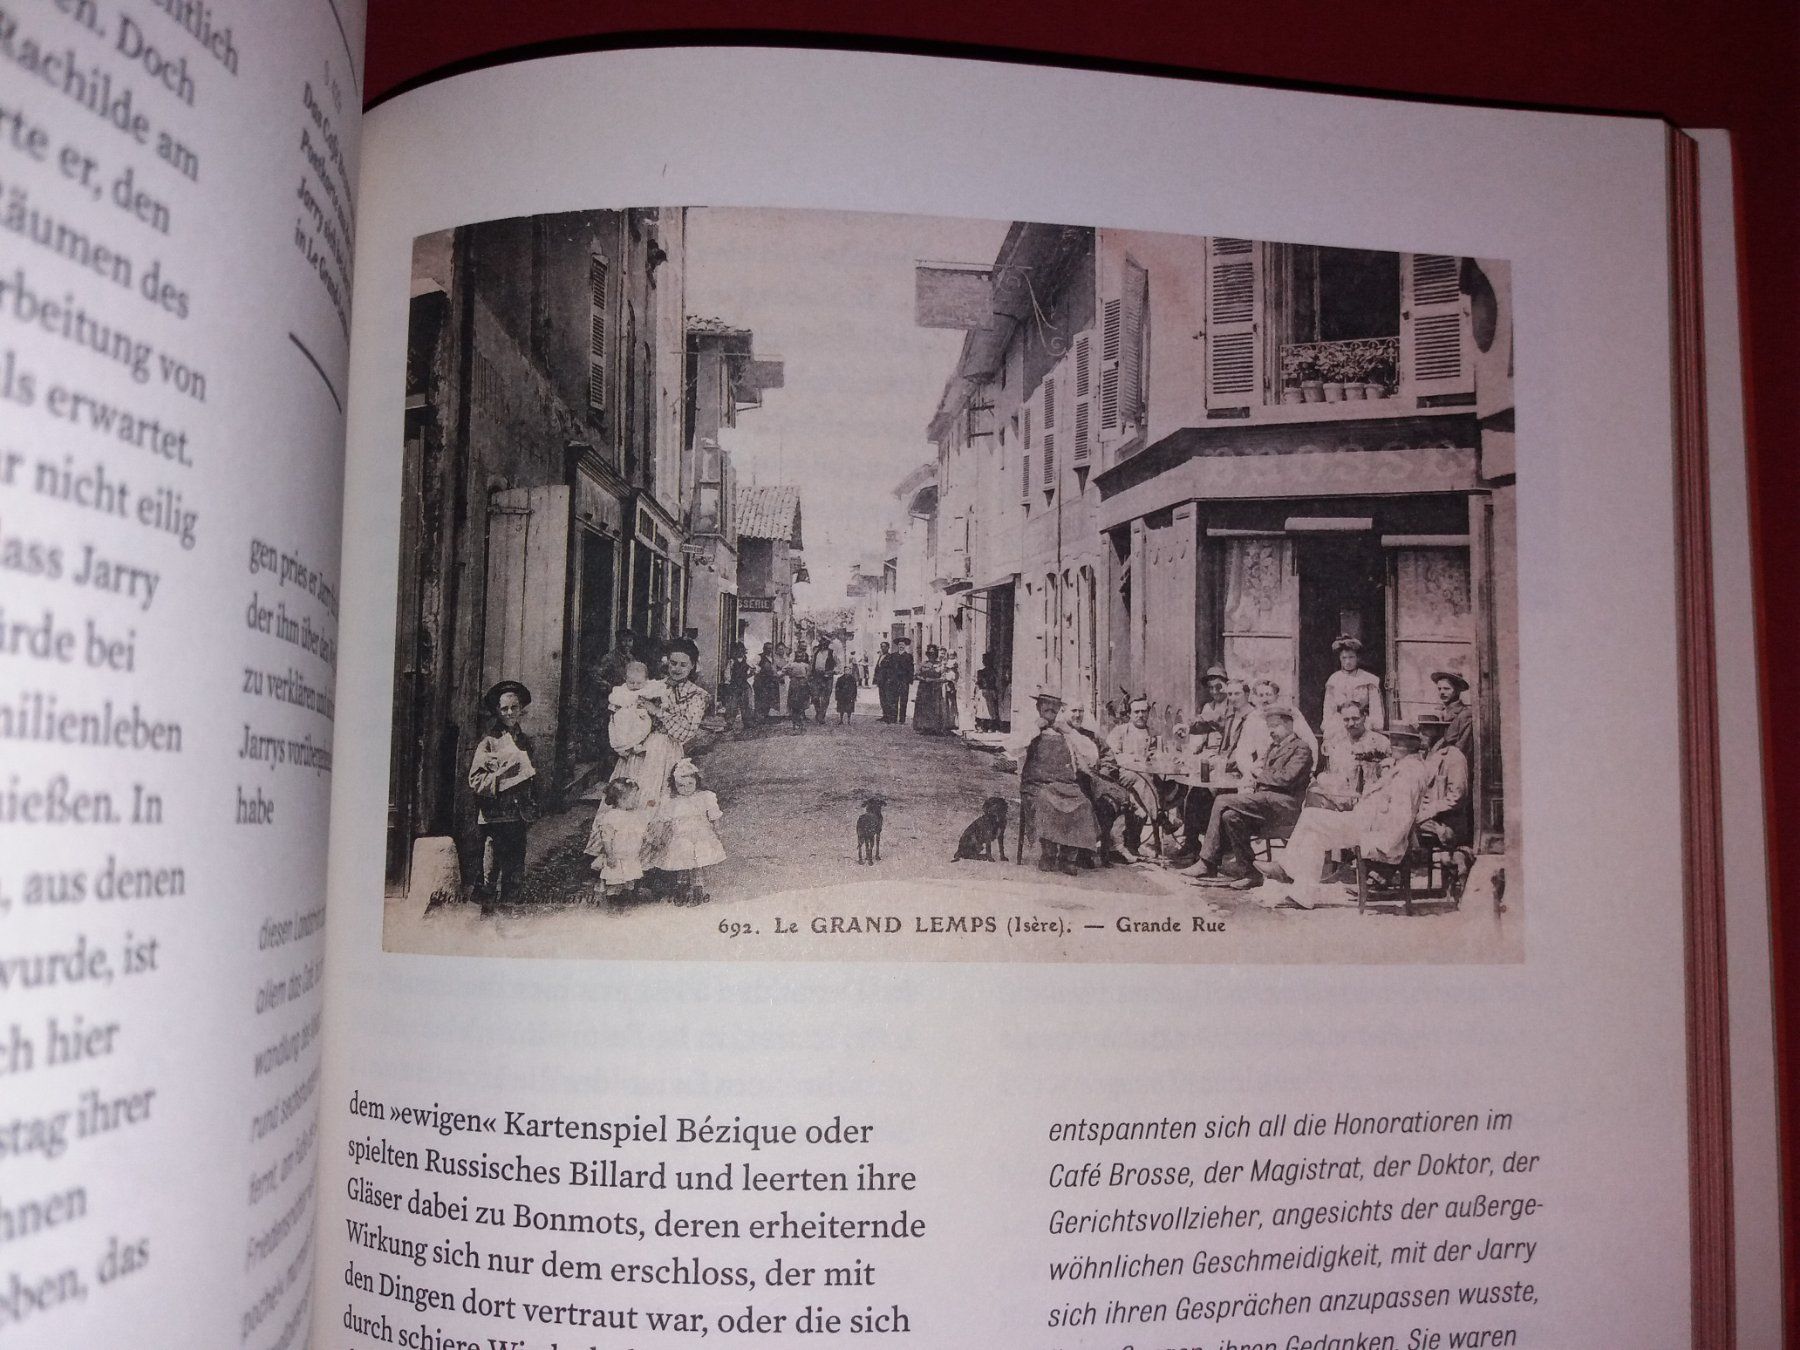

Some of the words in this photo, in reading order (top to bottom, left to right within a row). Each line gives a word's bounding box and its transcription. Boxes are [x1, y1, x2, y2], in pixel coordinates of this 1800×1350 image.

[116, 16, 194, 107] Doch
[156, 127, 199, 182] am
[59, 146, 101, 201] er,
[111, 165, 171, 234] den
[0, 184, 133, 289] äumen
[141, 259, 190, 319] des
[160, 352, 206, 402] von
[46, 384, 194, 467] erwartet.
[35, 455, 127, 518] nicht
[136, 487, 199, 550] eilig
[0, 523, 63, 580] ass
[74, 545, 160, 611] Jarry
[250, 539, 278, 574] gen
[247, 591, 274, 634] der
[276, 602, 299, 645] ihm
[86, 617, 136, 672] bei
[243, 668, 263, 696] zu
[239, 724, 285, 771] Jarrys
[0, 773, 121, 824] ießen.
[132, 784, 163, 825] In
[236, 785, 275, 825] habe
[24, 869, 87, 905] aus
[95, 854, 186, 900] denen
[717, 918, 759, 935] 692.
[774, 917, 799, 933] Le
[811, 917, 901, 933] GRAND
[915, 916, 997, 932] LEMPS
[1116, 916, 1181, 932] Grande
[1192, 917, 1226, 932] Rue
[123, 931, 160, 973] ist
[47, 1015, 120, 1067] hier
[77, 1086, 156, 1140] ihrer
[349, 1090, 385, 1120] dem
[390, 1105, 496, 1135] »ewigen«
[504, 1111, 667, 1148] Kartenspiel
[676, 1115, 797, 1150] Bézique
[805, 1116, 873, 1144] oder
[1048, 1117, 1197, 1145] entspannten
[1204, 1115, 1250, 1139] sich
[1258, 1113, 1286, 1138] all
[1294, 1112, 1326, 1137] die
[1333, 1109, 1480, 1136] Honoratioren
[1486, 1108, 1513, 1131] im
[348, 1135, 419, 1170] spielten
[425, 1148, 560, 1185] Russisches
[569, 1159, 666, 1189] Billard
[675, 1163, 733, 1191] und
[741, 1163, 848, 1191] leerten
[856, 1163, 917, 1191] ihre
[1049, 1161, 1102, 1189] Café
[1108, 1162, 1195, 1190] Brosse,
[1203, 1161, 1245, 1185] der
[1249, 1156, 1364, 1186] Magistrat,
[1373, 1155, 1411, 1179] der
[1417, 1152, 1494, 1178] Doktor,
[1502, 1150, 1540, 1175] der
[347, 1177, 402, 1211] Gläser
[408, 1190, 469, 1222] dabei
[475, 1204, 505, 1226] zu
[513, 1204, 645, 1240] Bonmots,
[654, 1210, 740, 1239] deren
[749, 1209, 926, 1239] erheiternde
[1049, 1205, 1264, 1235] Gerichtsvollzieher,
[1271, 1198, 1393, 1230] angesichts
[1399, 1197, 1439, 1221] der
[1444, 1193, 1544, 1222] außerge-
[98, 1236, 150, 1285] das
[346, 1219, 428, 1266] Wirkung
[432, 1240, 480, 1269] sich
[488, 1250, 533, 1275] nur
[541, 1251, 602, 1281] dem
[610, 1258, 756, 1290] erschloss,
[764, 1258, 815, 1287] der
[823, 1260, 875, 1287] mit
[1049, 1254, 1184, 1282] wöhnlichen
[1192, 1243, 1383, 1276] Geschmeidigkeit,
[1390, 1243, 1427, 1265] mit
[1433, 1239, 1472, 1264] der
[1477, 1237, 1538, 1265] Jarry
[343, 1304, 393, 1343] durch
[344, 1261, 374, 1293] den
[378, 1270, 455, 1313] Dingen
[462, 1288, 516, 1320] dort
[523, 1301, 638, 1330] vertraut
[646, 1311, 708, 1336] war,
[717, 1306, 786, 1335] oder
[795, 1304, 841, 1334] die
[850, 1305, 910, 1334] sich
[1047, 1303, 1097, 1328] sich
[1104, 1300, 1168, 1325] ihren
[1175, 1290, 1312, 1323] Gesprächen
[1319, 1288, 1450, 1314] anzupassen
[1457, 1281, 1539, 1306] wusste,
[1408, 1328, 1441, 1350] Sie
[1449, 1329, 1517, 1348] waren
